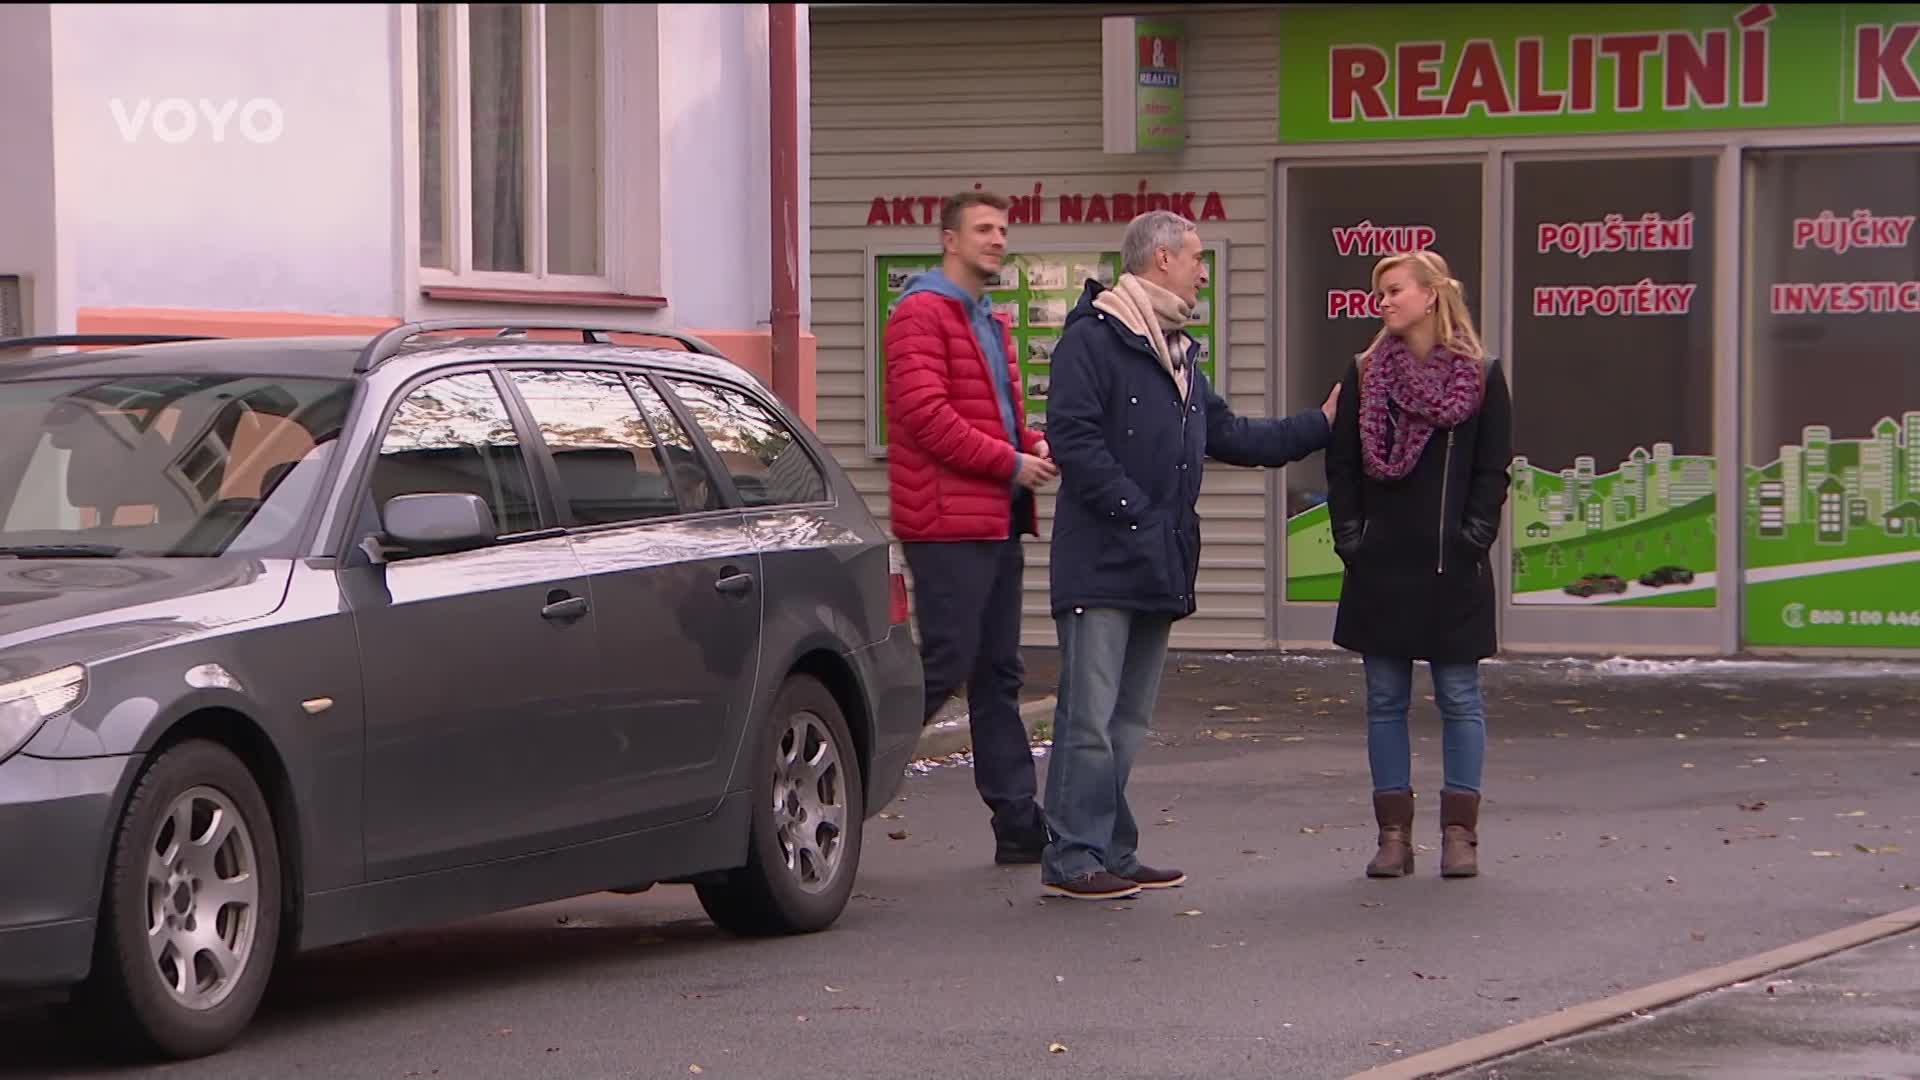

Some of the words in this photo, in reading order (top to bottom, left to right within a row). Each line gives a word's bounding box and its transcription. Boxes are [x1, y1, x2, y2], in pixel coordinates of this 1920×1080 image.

[1329, 4, 1776, 122] REALITNÍ
[1855, 23, 1920, 103] K
[866, 181, 1042, 225] AKTNÍ
[1059, 178, 1227, 224] NABÍDKA
[1332, 220, 1435, 256] VÝKUP
[1538, 212, 1695, 258] POJIŠTĚNÍ
[1794, 209, 1916, 254] PŮJČKY
[1534, 278, 1697, 316] HYPOTÉKY
[1771, 281, 1920, 314] INVESTIC
